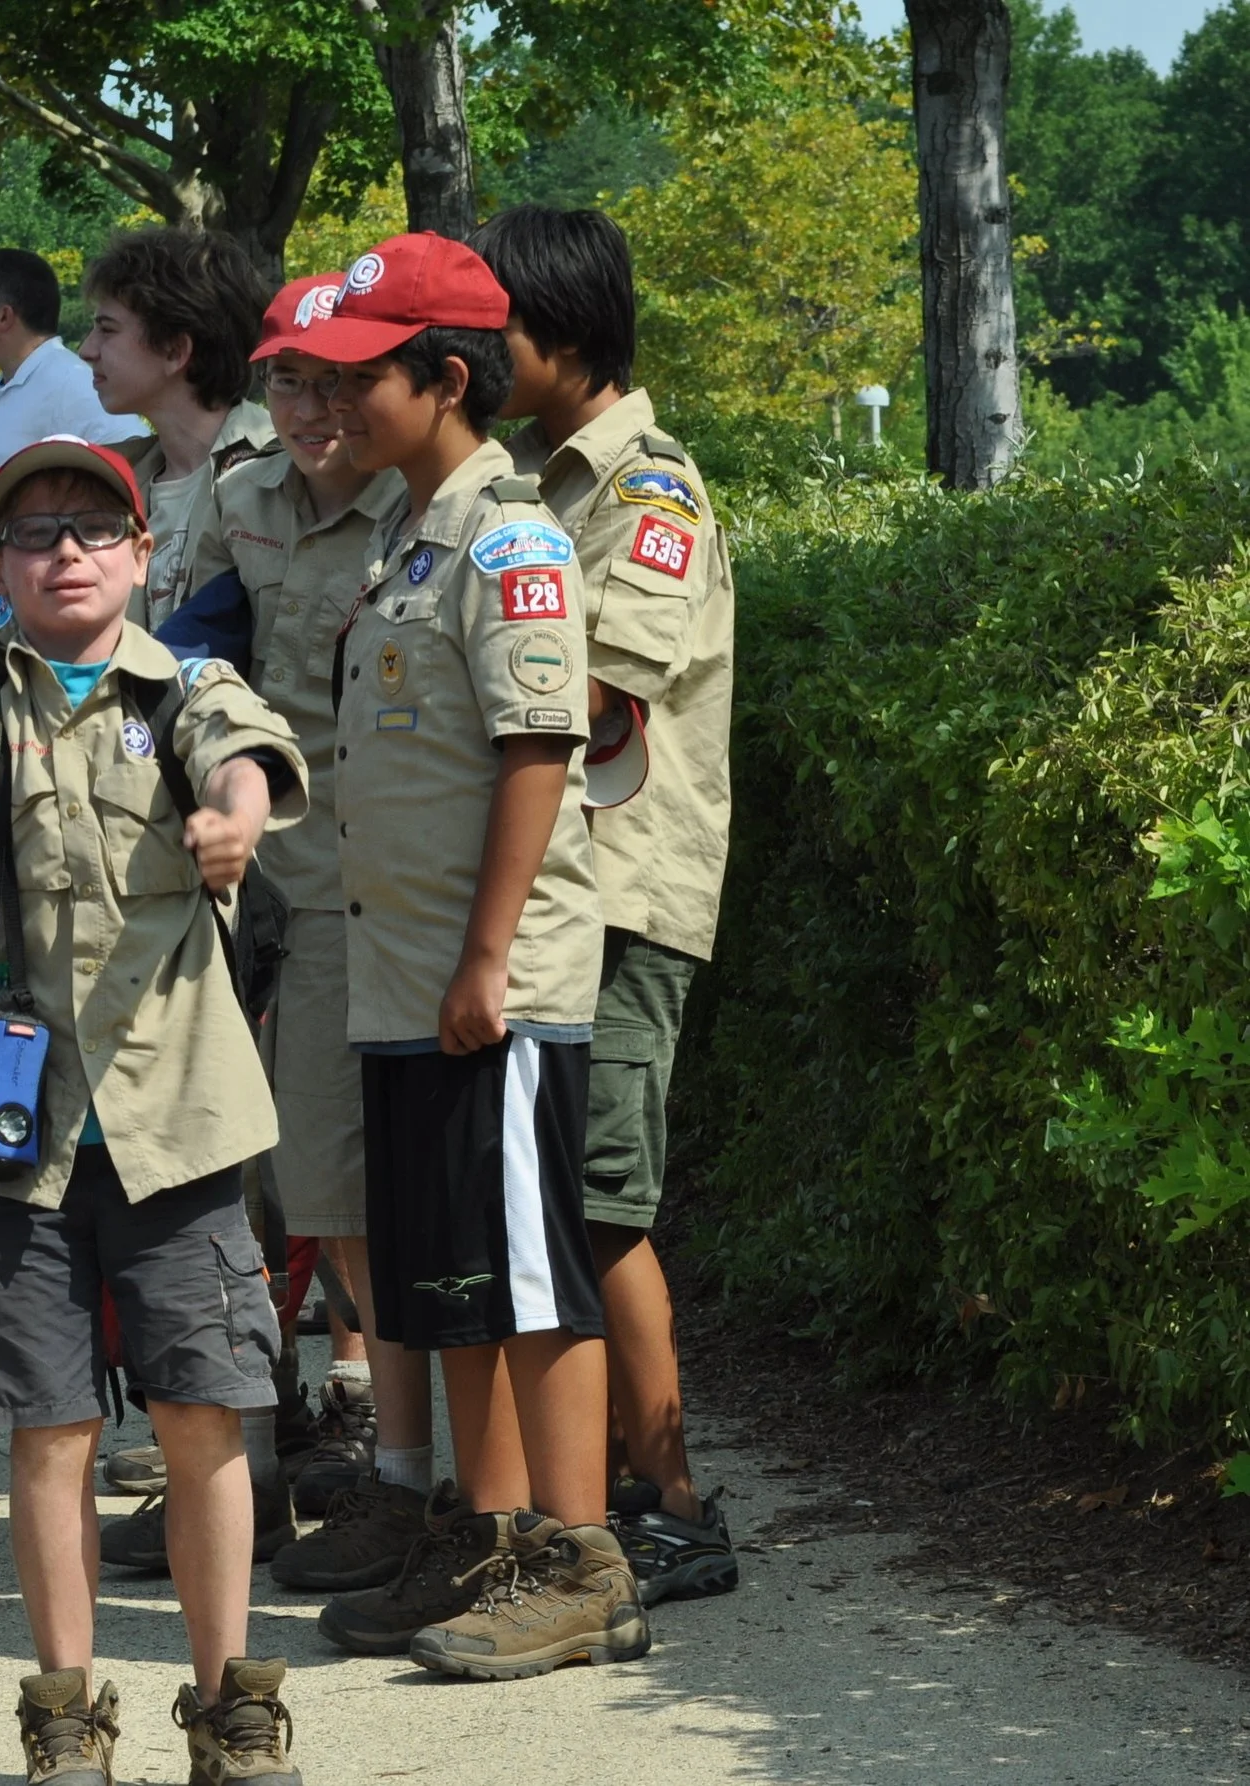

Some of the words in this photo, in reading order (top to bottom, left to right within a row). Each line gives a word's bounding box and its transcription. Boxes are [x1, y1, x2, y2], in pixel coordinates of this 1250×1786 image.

[257, 536, 284, 550] AMERICA
[640, 529, 687, 570] 535
[513, 582, 560, 614] 128
[534, 632, 559, 646] PATROL
[541, 713, 568, 723] Trained
